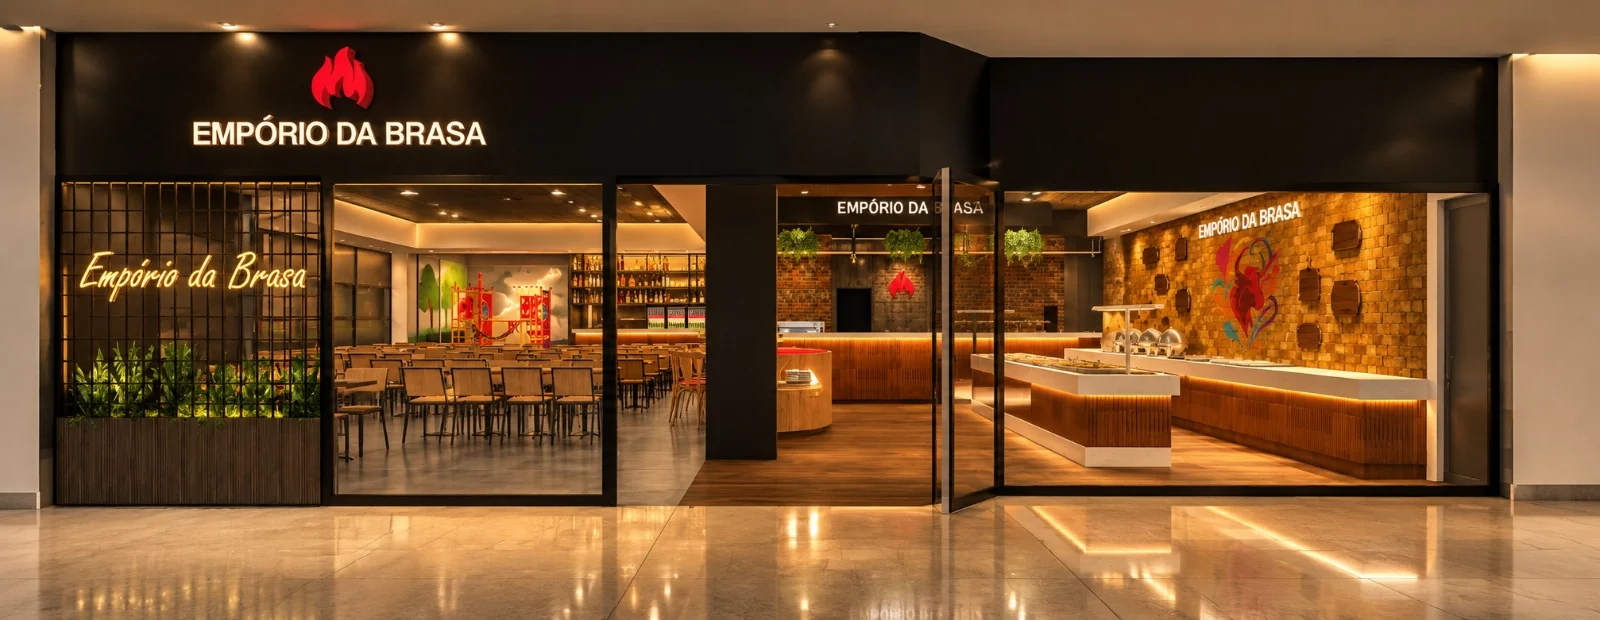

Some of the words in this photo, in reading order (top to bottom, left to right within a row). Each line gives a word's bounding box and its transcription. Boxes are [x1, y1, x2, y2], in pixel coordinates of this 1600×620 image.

[192, 114, 329, 146] EMPÓRIO
[336, 121, 378, 146] DA
[385, 121, 487, 146] BRASA
[837, 198, 904, 214] EMPÓRIO
[908, 201, 928, 214] DA
[934, 201, 984, 214] BASA
[1198, 216, 1239, 238] EMPÓRIO
[1242, 212, 1257, 229] DA
[1259, 201, 1301, 225] BRASA
[79, 251, 178, 303] Empório
[188, 254, 216, 288] da
[228, 251, 307, 290] Brasa
